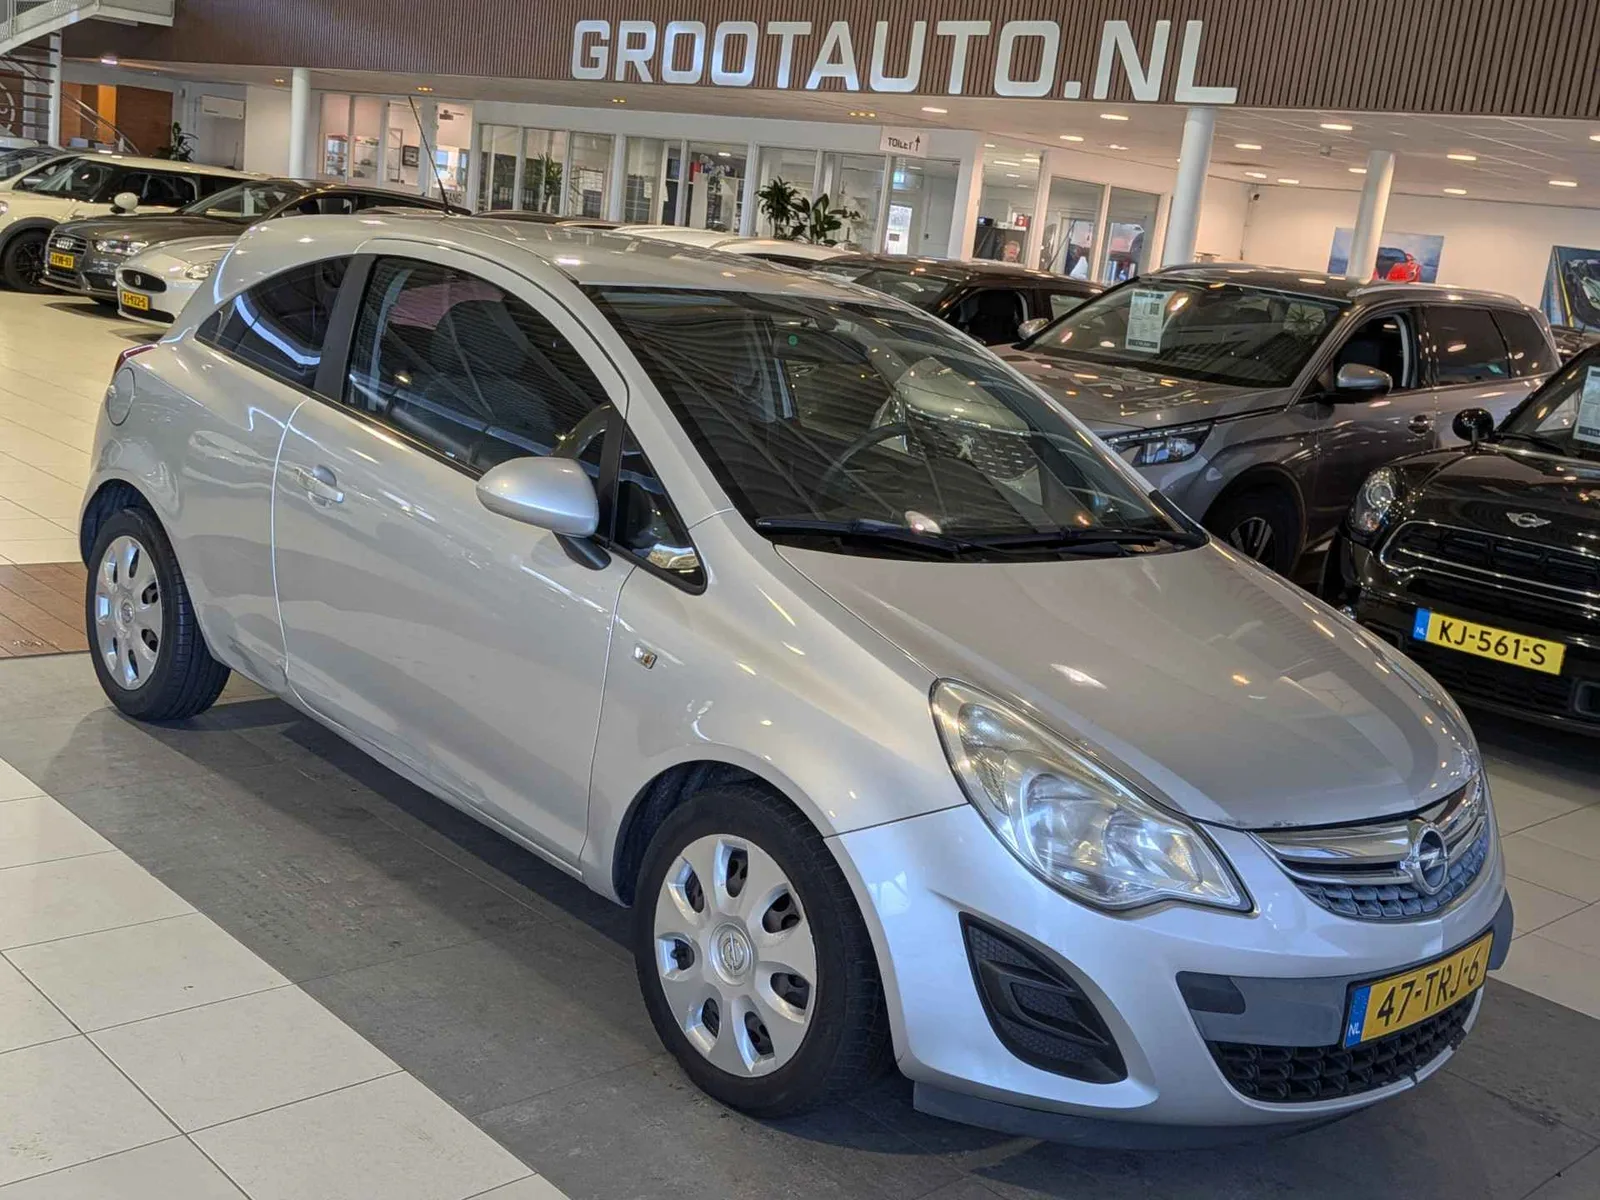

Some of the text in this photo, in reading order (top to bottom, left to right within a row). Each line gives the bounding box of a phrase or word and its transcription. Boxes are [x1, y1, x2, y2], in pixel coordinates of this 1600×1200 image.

[571, 19, 1239, 104] GROOTAUTO.NL
[888, 136, 914, 151] TOILET
[1415, 620, 1547, 666] NL KJ-561-S
[1348, 946, 1482, 1037] NL 47-TRJ-6
